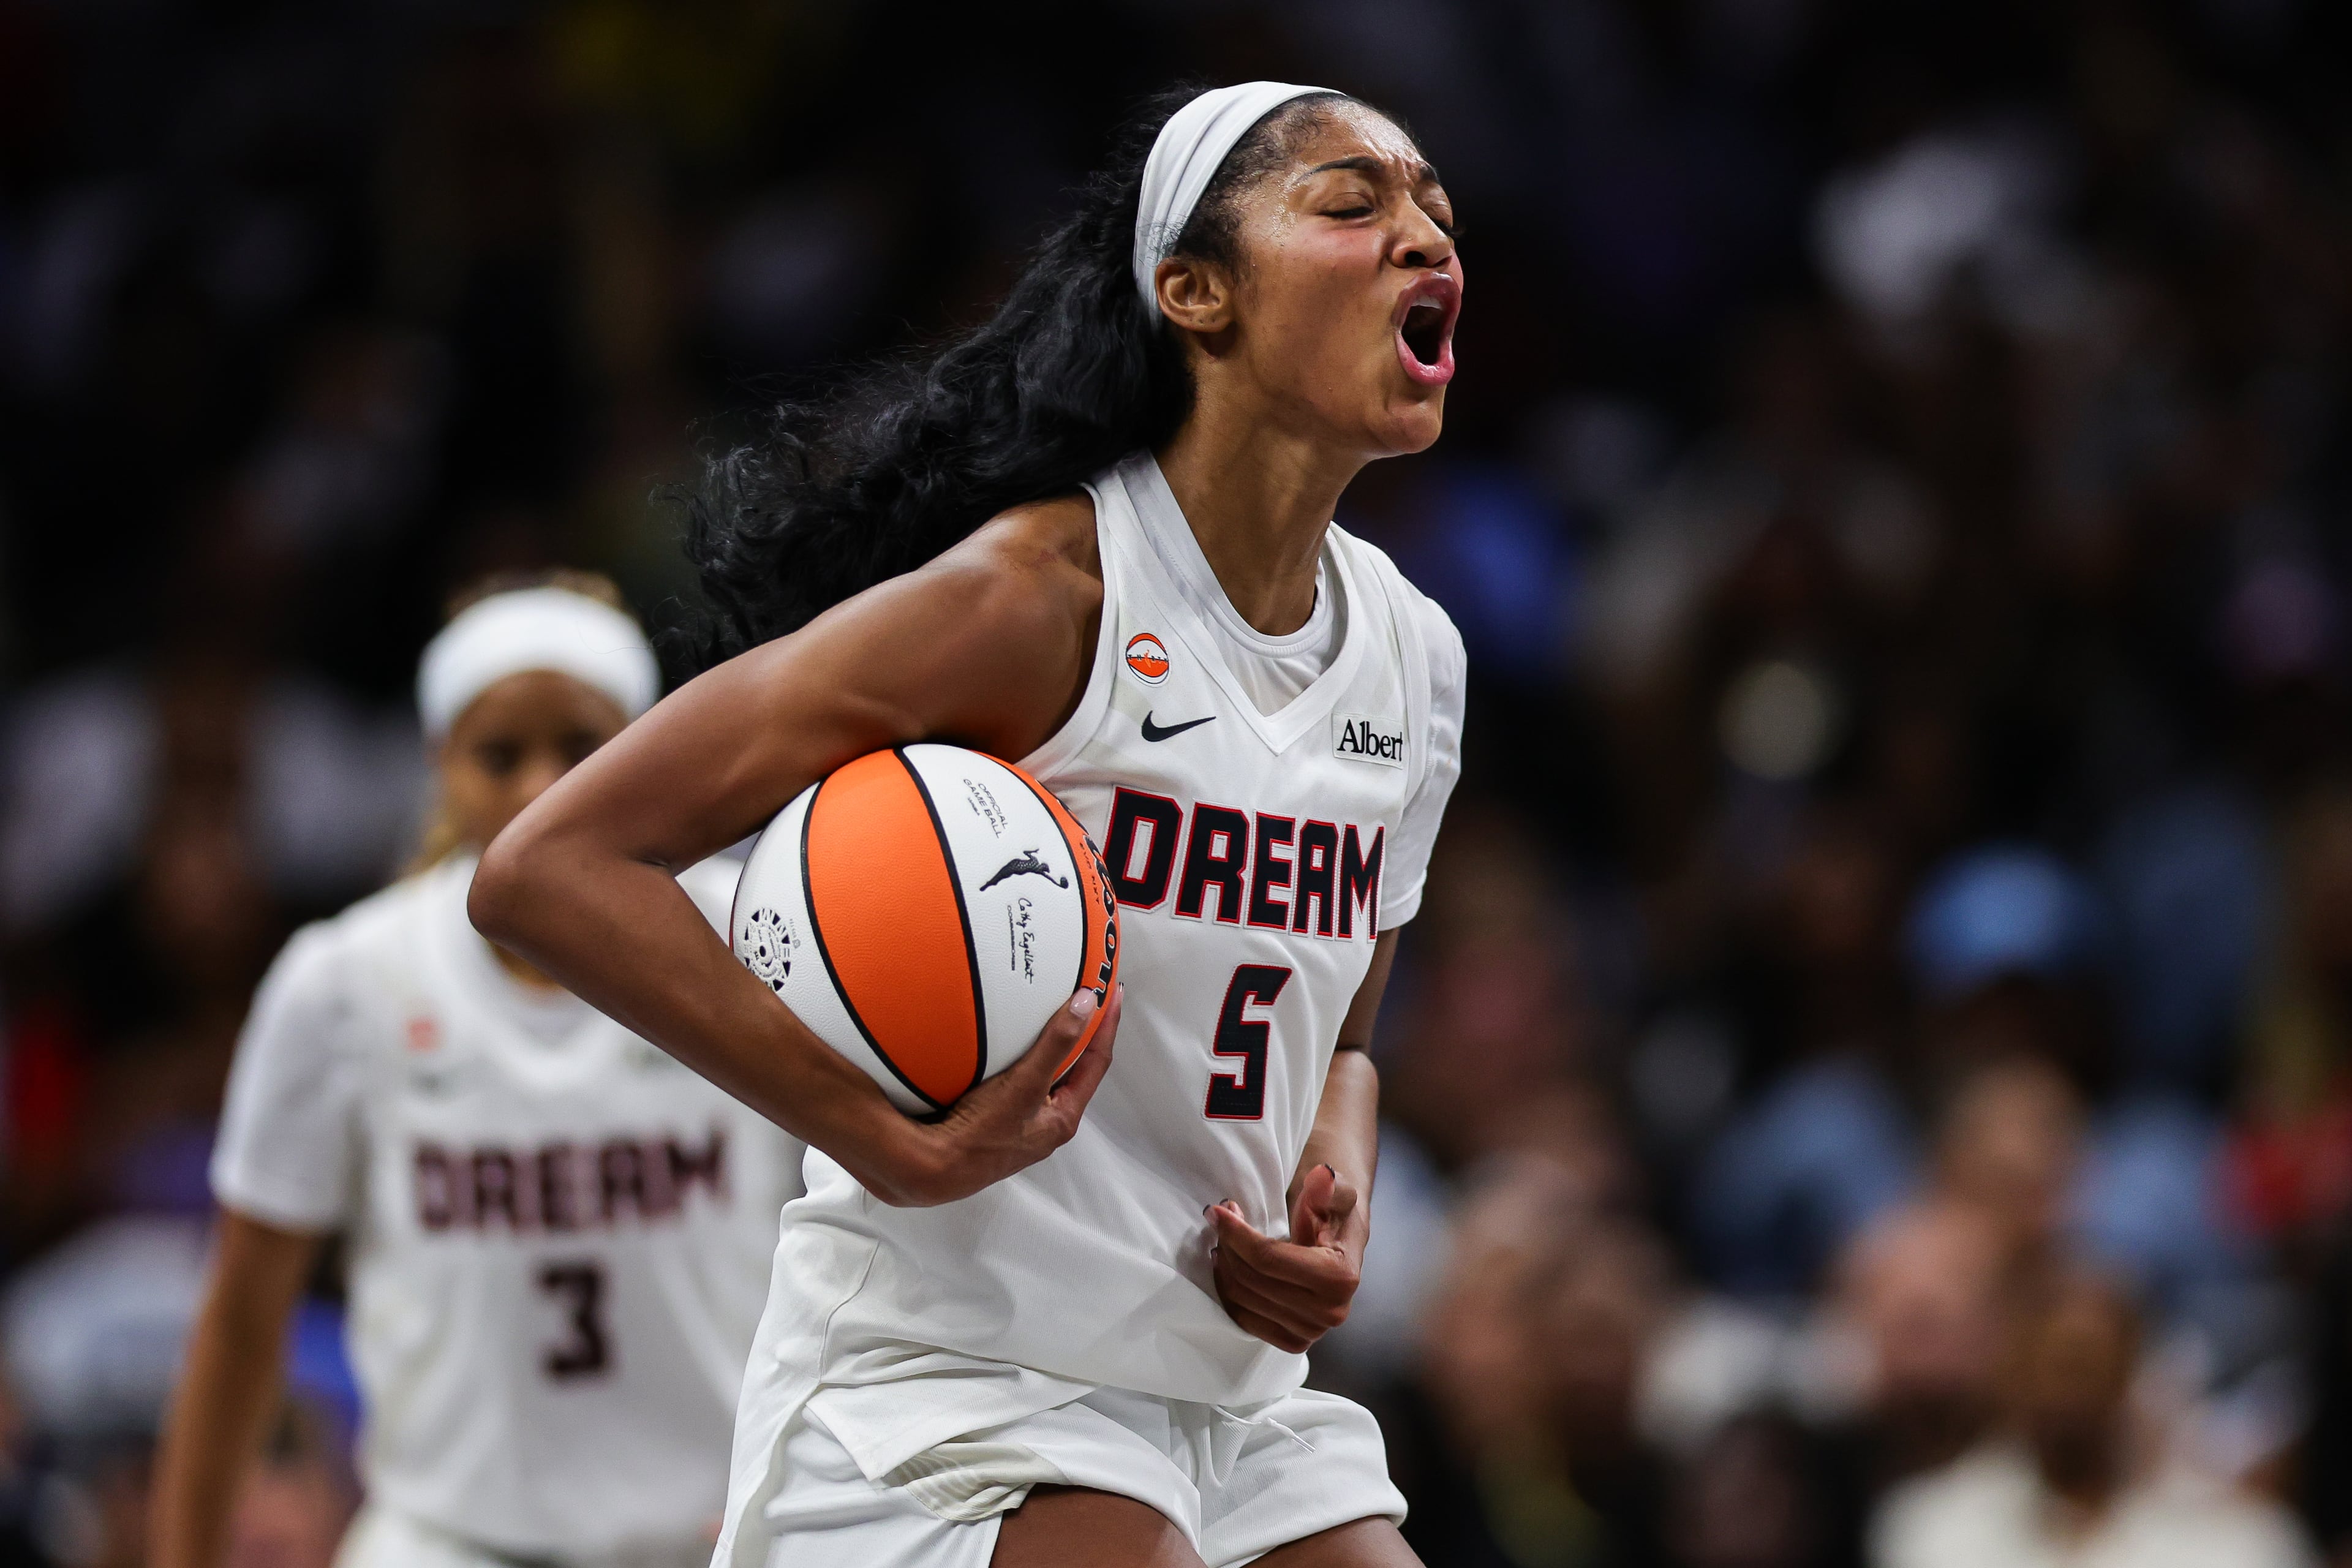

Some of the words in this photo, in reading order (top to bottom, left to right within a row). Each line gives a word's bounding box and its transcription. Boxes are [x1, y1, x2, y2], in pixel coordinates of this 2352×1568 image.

[1336, 718, 1403, 761] Albert
[963, 779, 987, 807] GAME
[984, 809, 1003, 839] BALL
[978, 783, 1009, 829] OFFICIAL
[1105, 786, 1385, 941] DREAM
[1205, 964, 1292, 1120] 5
[414, 1126, 729, 1231] DREAM
[539, 1262, 611, 1378] 3
